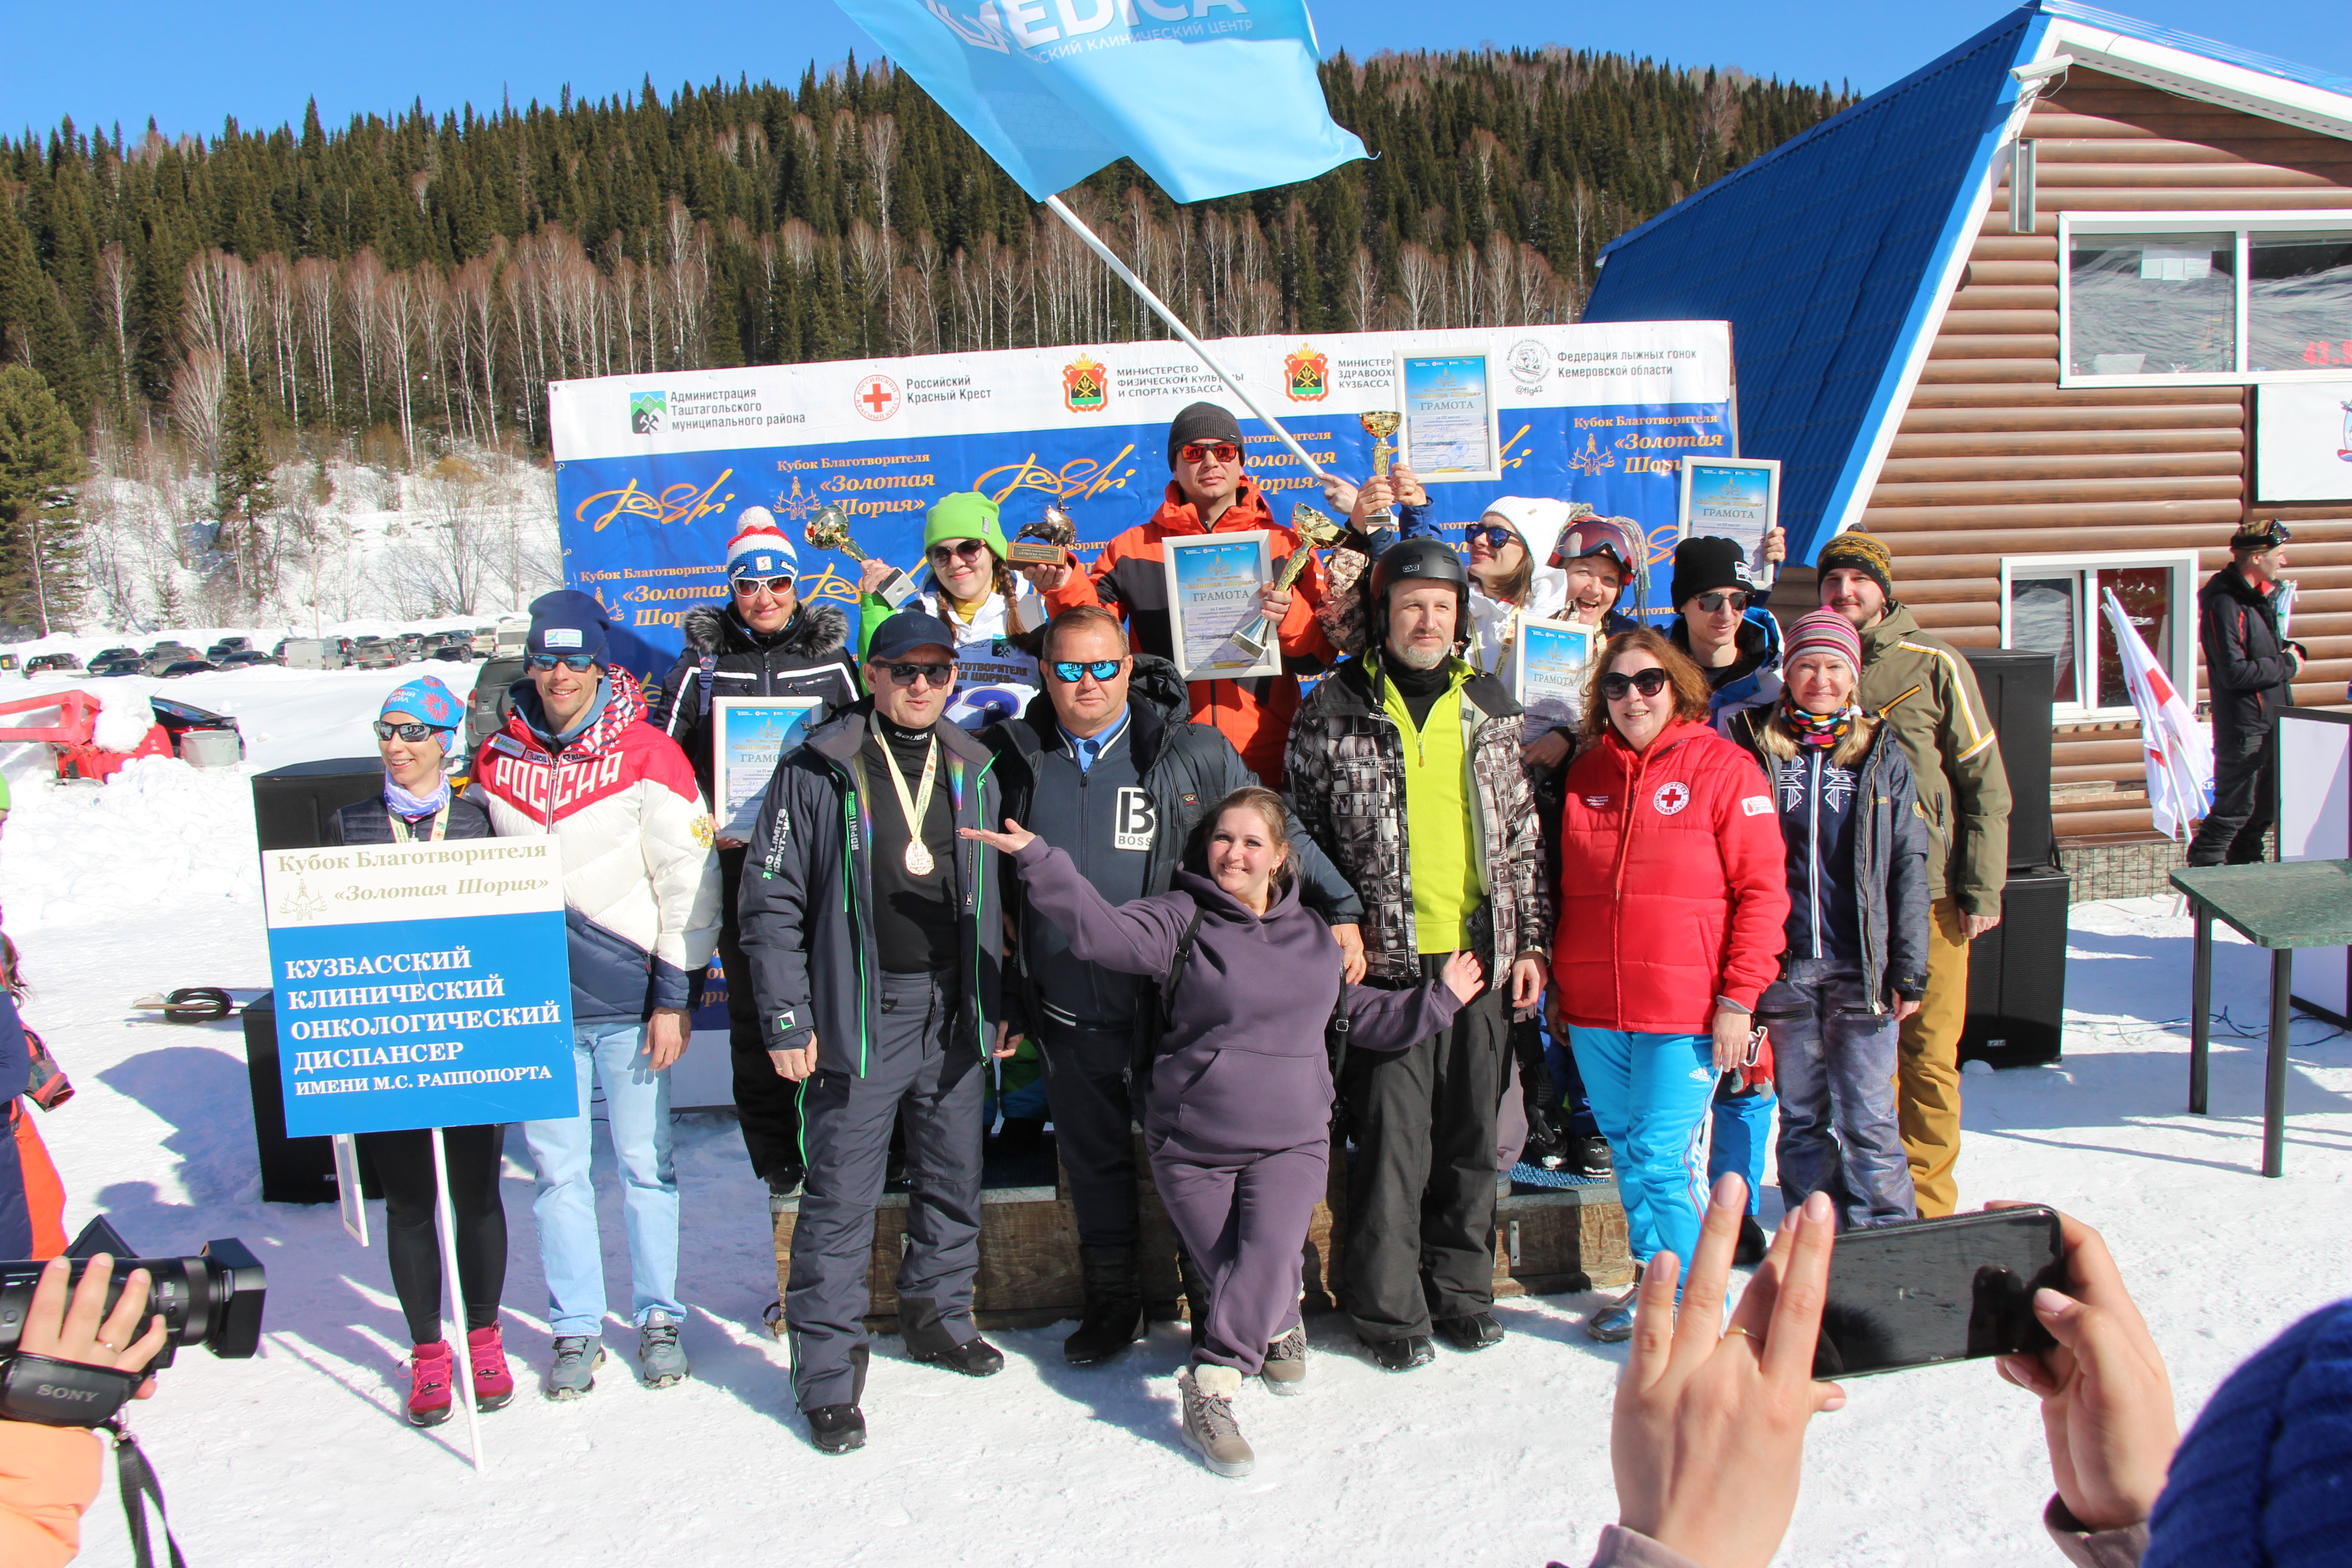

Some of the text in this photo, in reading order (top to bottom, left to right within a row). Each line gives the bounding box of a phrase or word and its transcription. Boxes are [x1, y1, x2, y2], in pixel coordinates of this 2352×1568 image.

[1087, 21, 1204, 51] КЛИНИЧЕСКИЙ
[1208, 19, 1253, 34] ЦЕНТР
[1338, 359, 1395, 368] МИНИСТЕР
[1557, 350, 1697, 363] Федерация лыжных гонок
[1117, 365, 1199, 377] МИНИСТЕРСТВО
[1117, 373, 1244, 387] ФИЗИЧЕСКОЙ КУЛЬТЫ
[1558, 364, 1673, 378] Кемеровской области
[857, 376, 898, 395] РОССИЙСКИЙ
[906, 374, 971, 390] Российский
[1127, 387, 1169, 397] СПОРТА
[1171, 384, 1224, 394] КУЗБАССА
[1339, 379, 1390, 389] КУЗБАССА
[1515, 385, 1544, 396] @flg42
[670, 388, 757, 403] Администрация
[907, 387, 992, 405] Красный Крест
[671, 402, 762, 416] Таштагольского
[856, 396, 899, 420] КРАСНЫЙ КРЕСТ
[1420, 401, 1475, 411] ГРАМОТА
[671, 413, 805, 431] муниципального района
[1574, 413, 1718, 429] Кубок Благотворителя
[1613, 431, 1724, 450] «Золотая
[777, 454, 931, 472] Кубок Благотворителя
[1623, 456, 1682, 475] Шори
[819, 473, 935, 493] «Золотая
[832, 498, 926, 519] Шория»
[1702, 508, 1755, 519] ГРАМОТА
[580, 564, 727, 583] Кубок Благотворителя
[622, 584, 730, 603] «Золотая
[1192, 590, 1250, 602] ГРАМОТА
[633, 608, 684, 628] Шор
[954, 662, 1028, 676] АГОТВОРИТЕЛЯ
[971, 672, 1016, 683] ШОРИЯ»
[1534, 673, 1574, 686] ГРАМОТА
[531, 754, 547, 763] LUKOIL
[740, 754, 779, 763] ГРАМО
[765, 808, 787, 871] NO LIMITS
[849, 821, 860, 851] RDPNT
[1118, 835, 1152, 846] BOSS
[278, 845, 547, 875] Кубок Благотворителя
[334, 877, 549, 902] «Золотая Шория»
[285, 945, 472, 980] КУЗБАССКИЙ
[288, 973, 505, 1010] КЛИНИЧЕСКИЙ
[290, 1000, 561, 1041] ОНКОЛОГИЧЕСКИЙ
[293, 1042, 464, 1075] ДИСПАНСЕР
[295, 1065, 552, 1096] ИМЕНИ М.С. РАППОПОРТА
[1689, 1072, 1710, 1082] adidas
[37, 1383, 100, 1403] SONY
